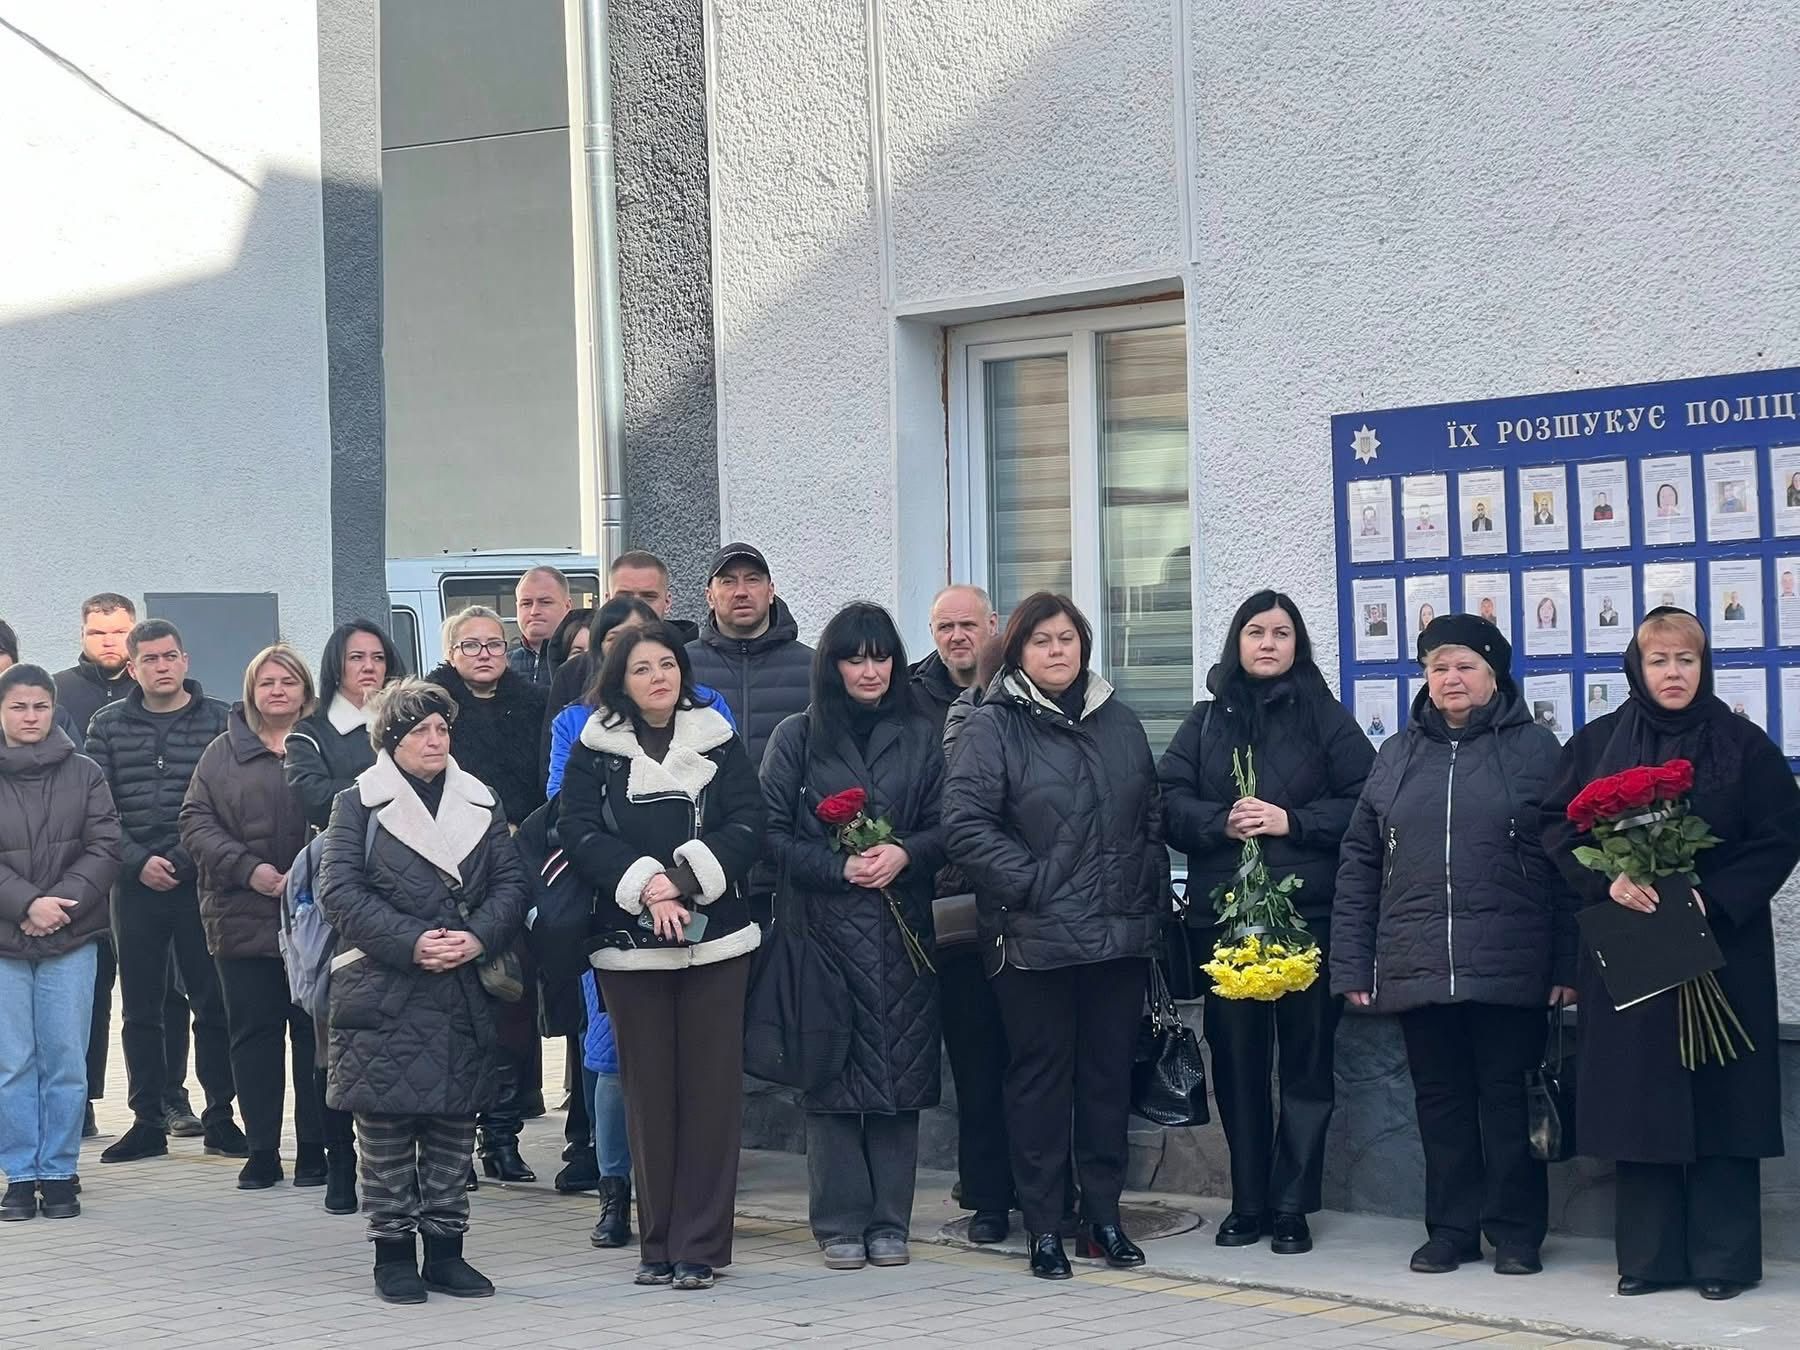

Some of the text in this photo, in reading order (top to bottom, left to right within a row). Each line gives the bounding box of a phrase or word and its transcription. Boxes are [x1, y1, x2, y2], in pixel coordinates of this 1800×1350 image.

[1447, 391, 1800, 449] ЇХ РОЗШУКУЄ ПОЛІЦ
